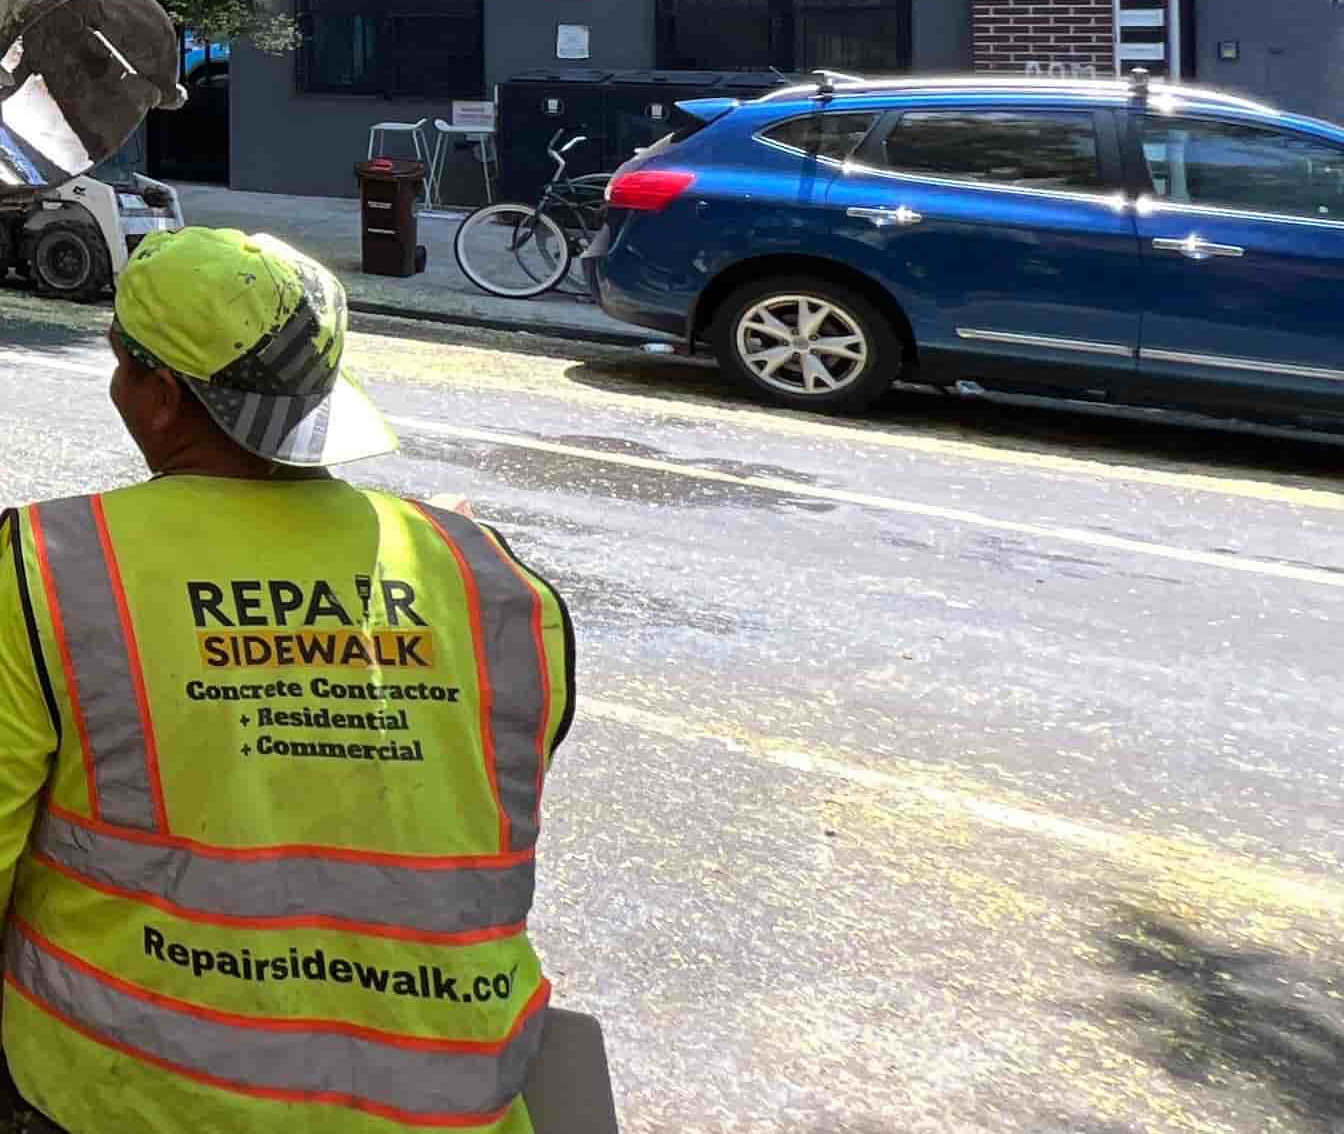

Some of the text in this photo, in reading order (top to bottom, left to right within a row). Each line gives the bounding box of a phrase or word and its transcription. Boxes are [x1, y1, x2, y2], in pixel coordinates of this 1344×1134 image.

[204, 634, 430, 666] SIDEWALK
[186, 678, 460, 702] Concrete Contractor
[258, 708, 409, 731] Residential
[257, 736, 424, 761] Commercial
[144, 926, 519, 1004] Repairsidewalk.co
